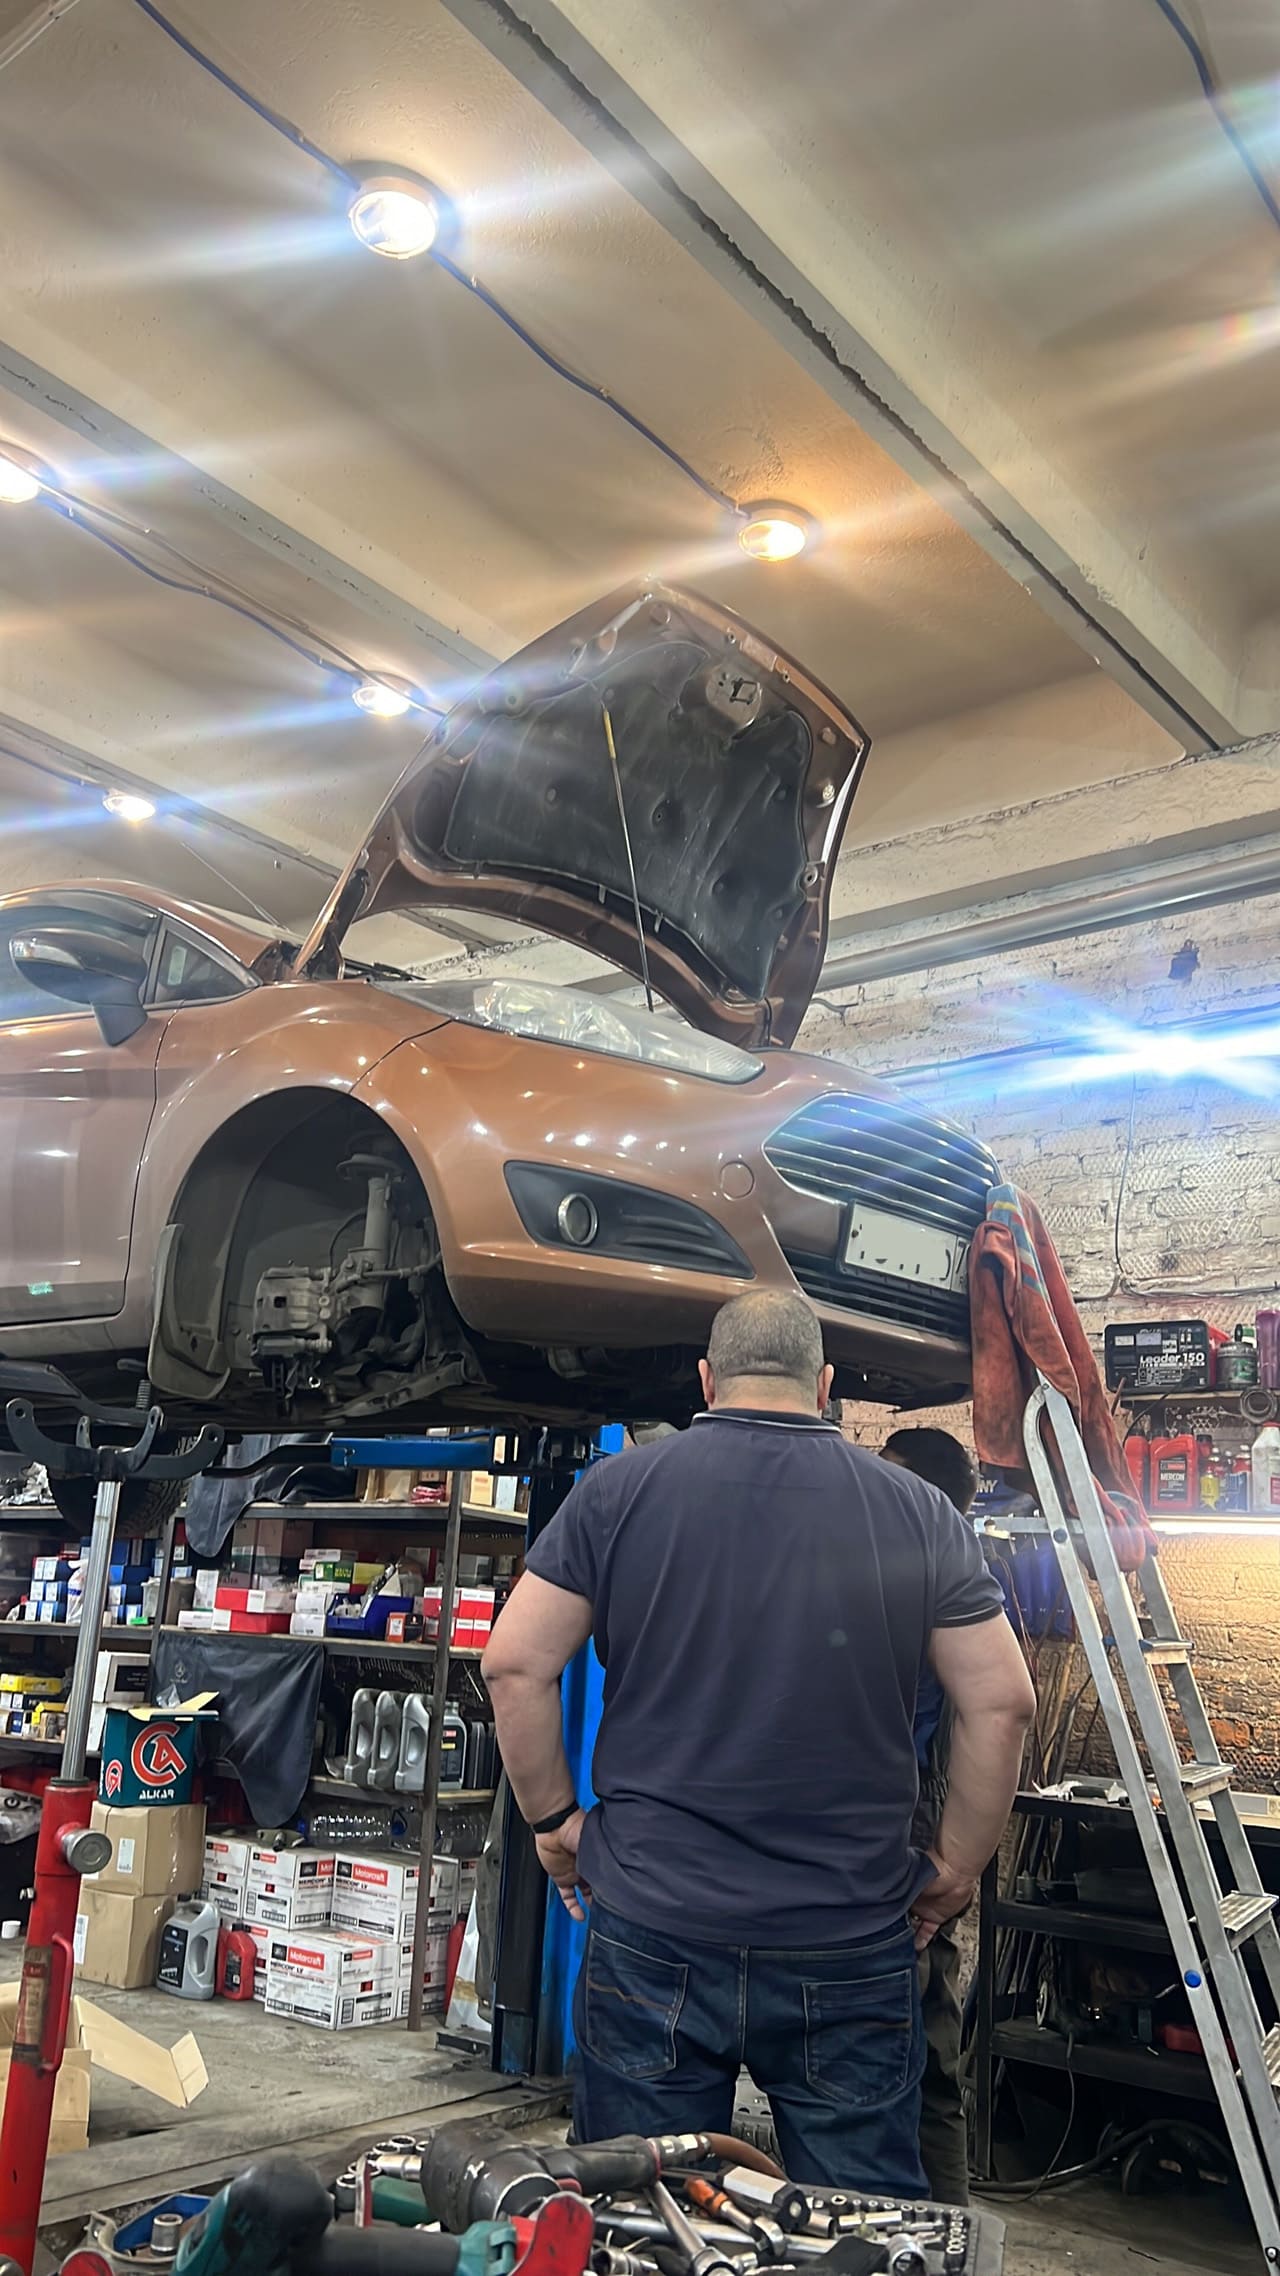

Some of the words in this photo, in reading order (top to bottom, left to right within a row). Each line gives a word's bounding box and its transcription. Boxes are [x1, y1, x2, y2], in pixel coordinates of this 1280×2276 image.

[1139, 1352, 1181, 1364] Leader
[1182, 1352, 1205, 1362] 150
[1160, 1472, 1185, 1481] MERCON
[138, 1789, 175, 1800] ALKAR
[354, 1866, 385, 1883] Motorcraft
[289, 1949, 321, 1967] Motorcraft
